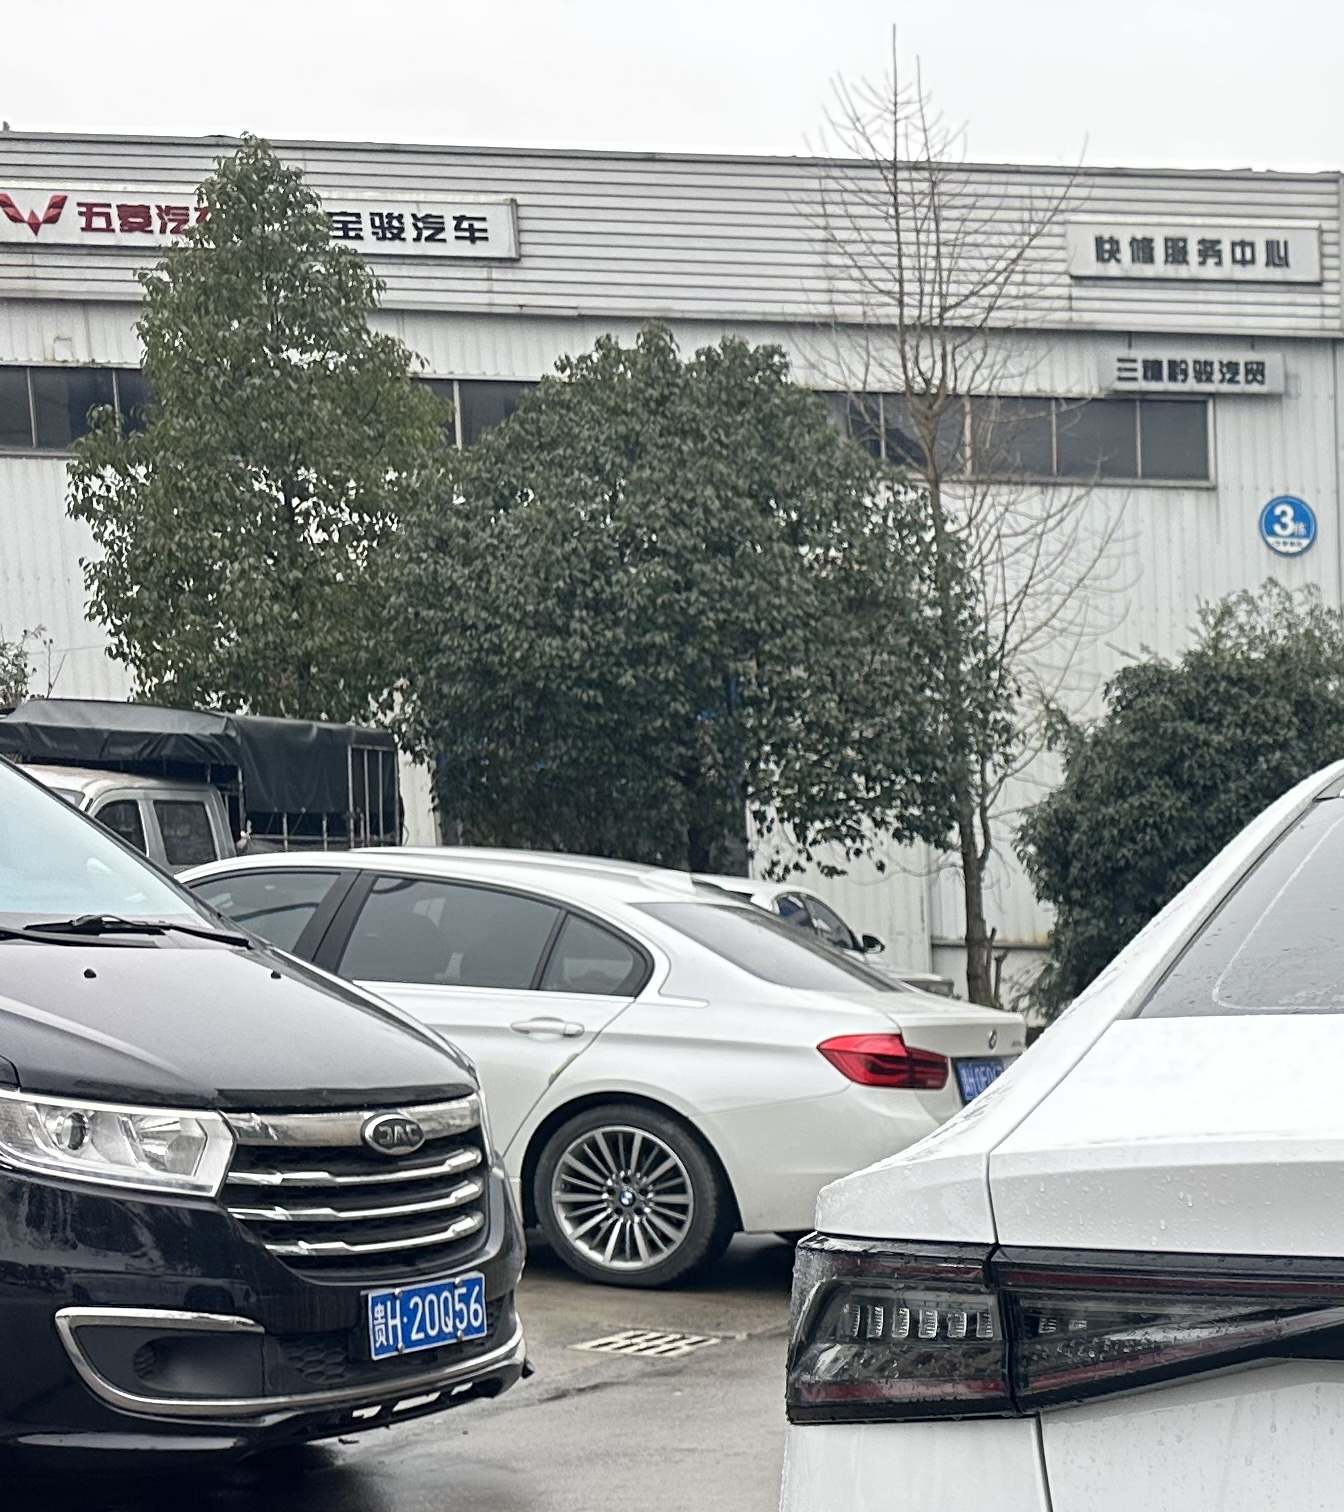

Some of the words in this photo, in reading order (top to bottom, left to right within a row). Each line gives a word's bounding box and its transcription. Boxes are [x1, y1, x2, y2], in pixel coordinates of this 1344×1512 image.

[326, 211, 489, 244] 宝骏汽车
[1095, 236, 1290, 268] 快修服务中心
